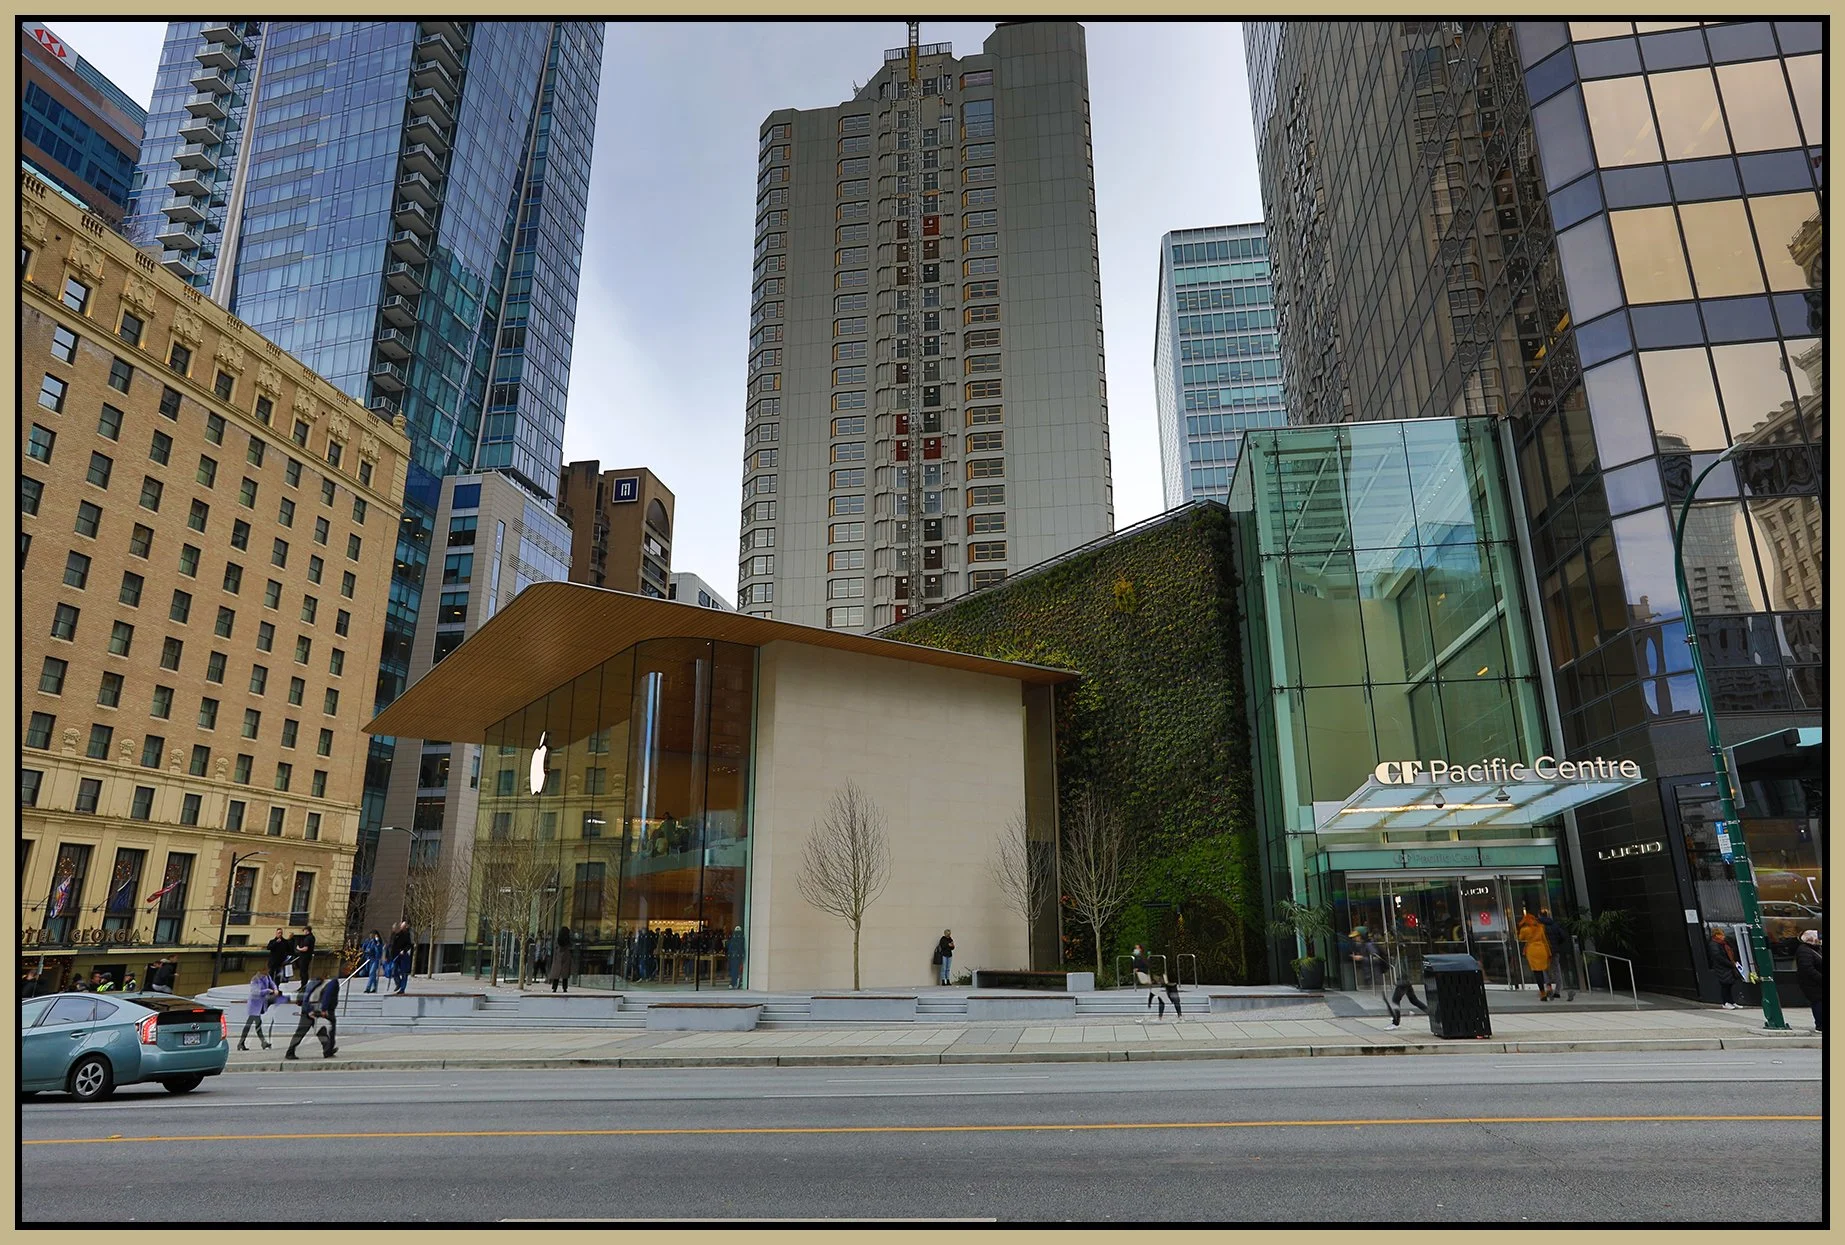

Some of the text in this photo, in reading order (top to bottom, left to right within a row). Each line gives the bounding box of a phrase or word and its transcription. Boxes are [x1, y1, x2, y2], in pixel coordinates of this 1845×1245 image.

[1374, 755, 1638, 785] CF Pacific Centre
[1598, 841, 1662, 860] LUCID
[71, 928, 140, 942] GEORGIA
